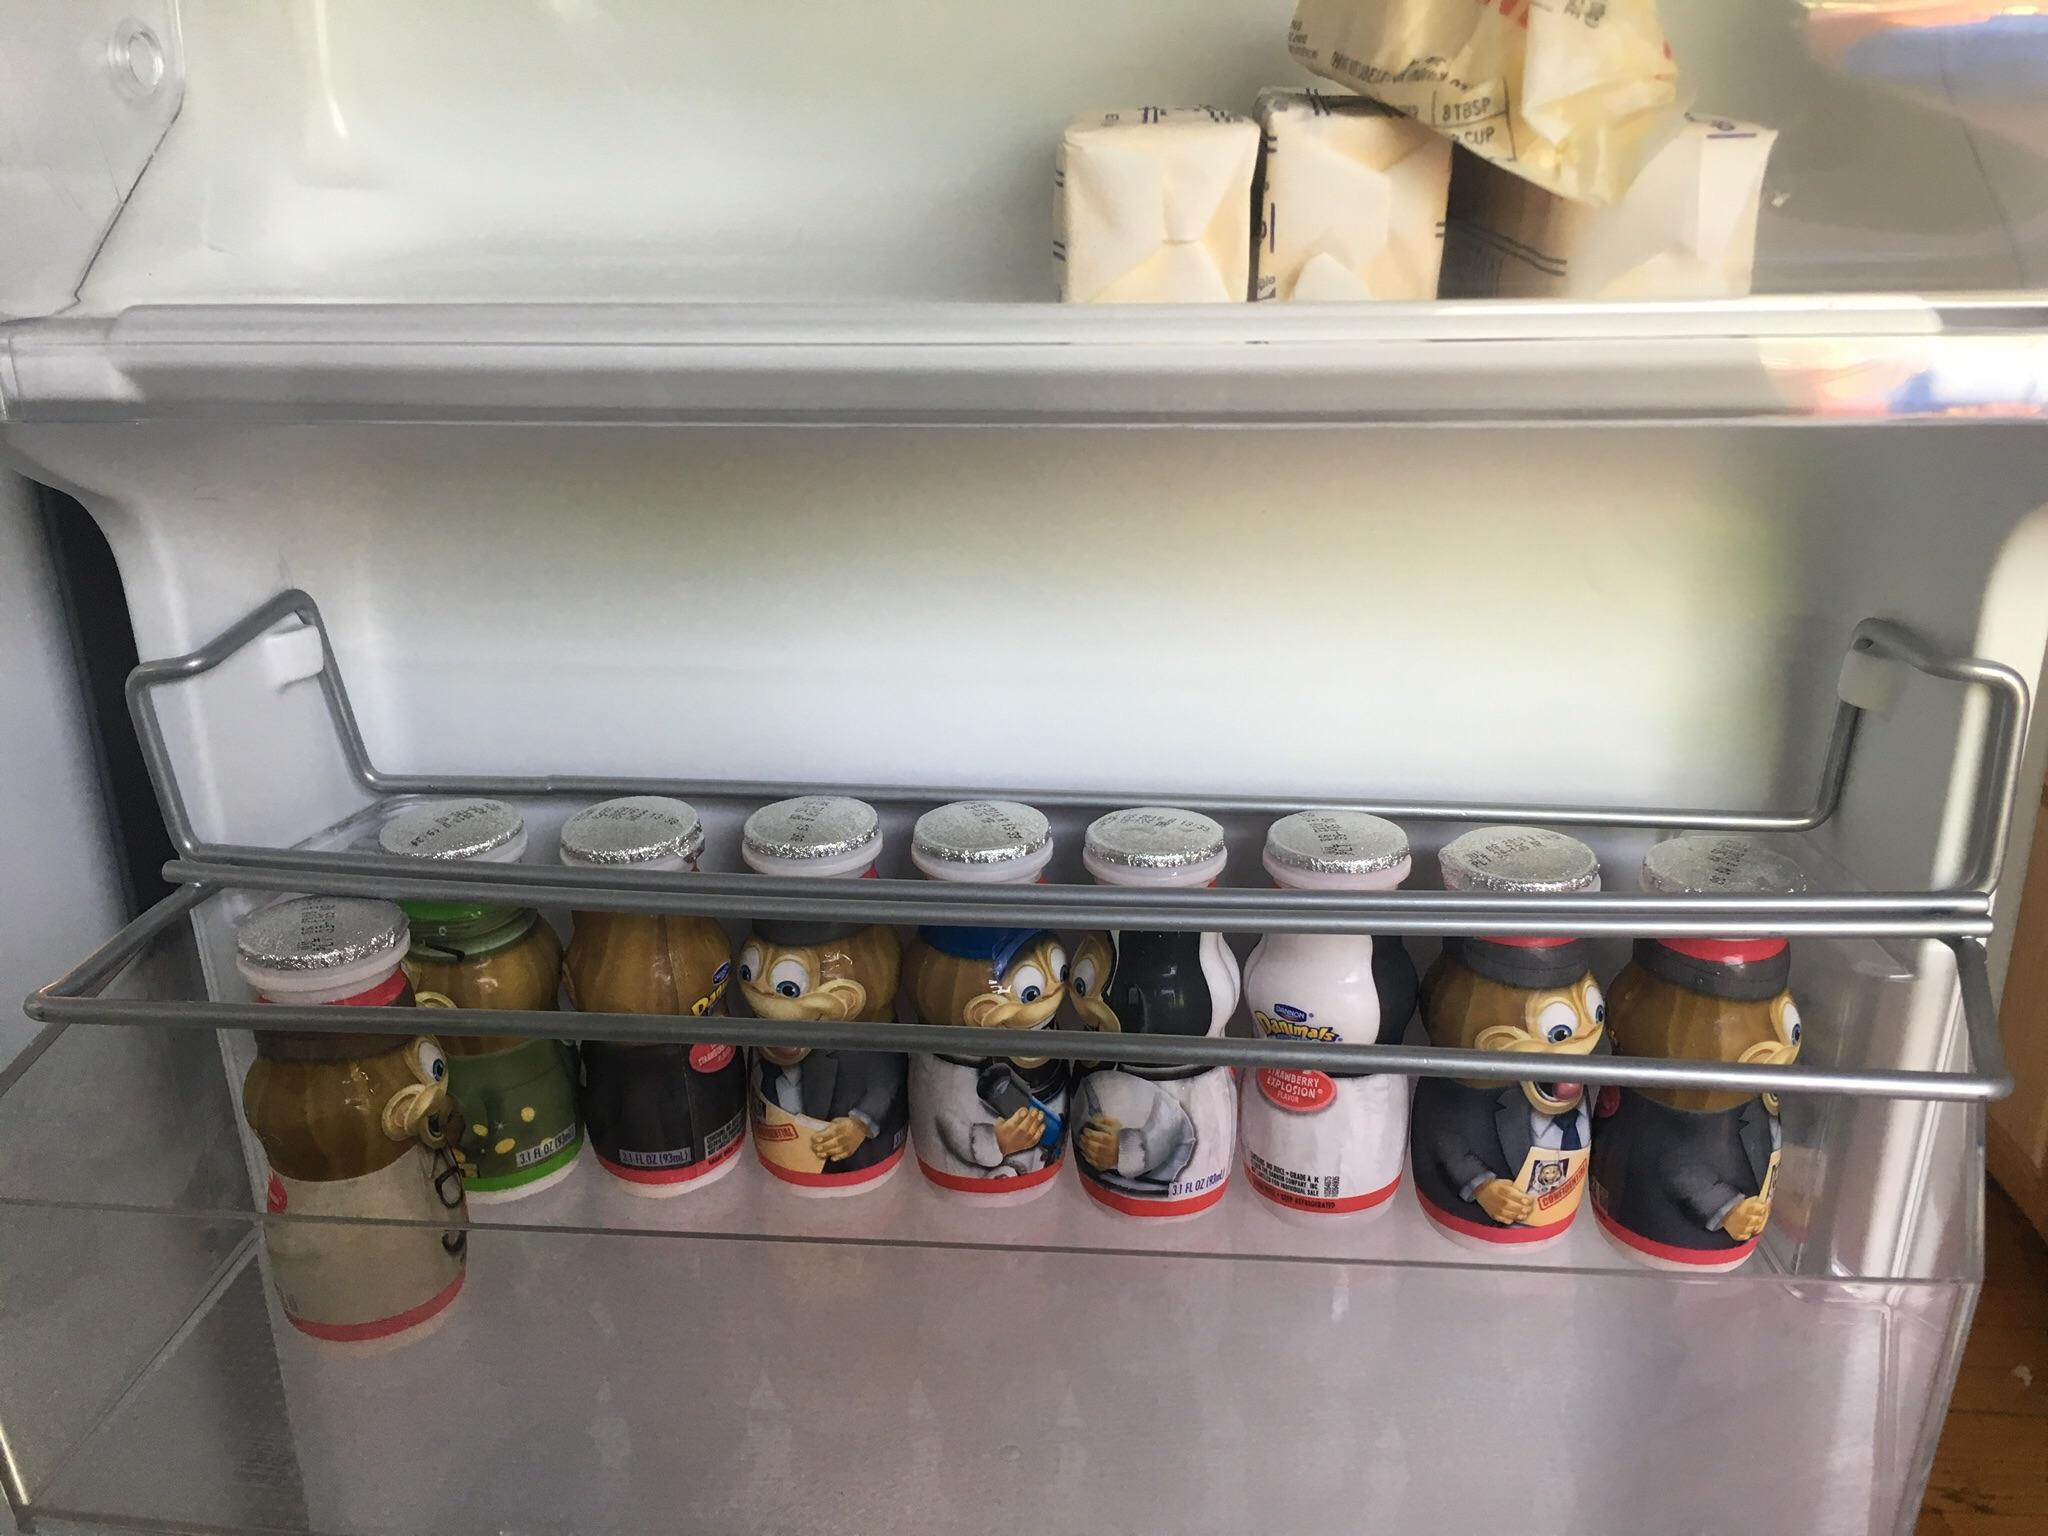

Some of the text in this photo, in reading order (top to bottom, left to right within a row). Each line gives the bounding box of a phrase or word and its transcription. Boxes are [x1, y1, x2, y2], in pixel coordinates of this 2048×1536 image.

[1466, 126, 1495, 145] CUP
[1276, 1005, 1305, 1020] DANNON
[1254, 1010, 1340, 1042] Danimals
[1267, 1068, 1320, 1088] STRAWBERRY
[1277, 1090, 1299, 1103] FLAVOR
[520, 1152, 531, 1165] 3.1
[544, 1141, 554, 1154] OZ
[635, 1154, 644, 1164] FL
[646, 1154, 658, 1165] OZ
[1172, 1184, 1182, 1195] 3.1
[1185, 1182, 1193, 1193] FL
[1195, 1178, 1205, 1191] OZ
